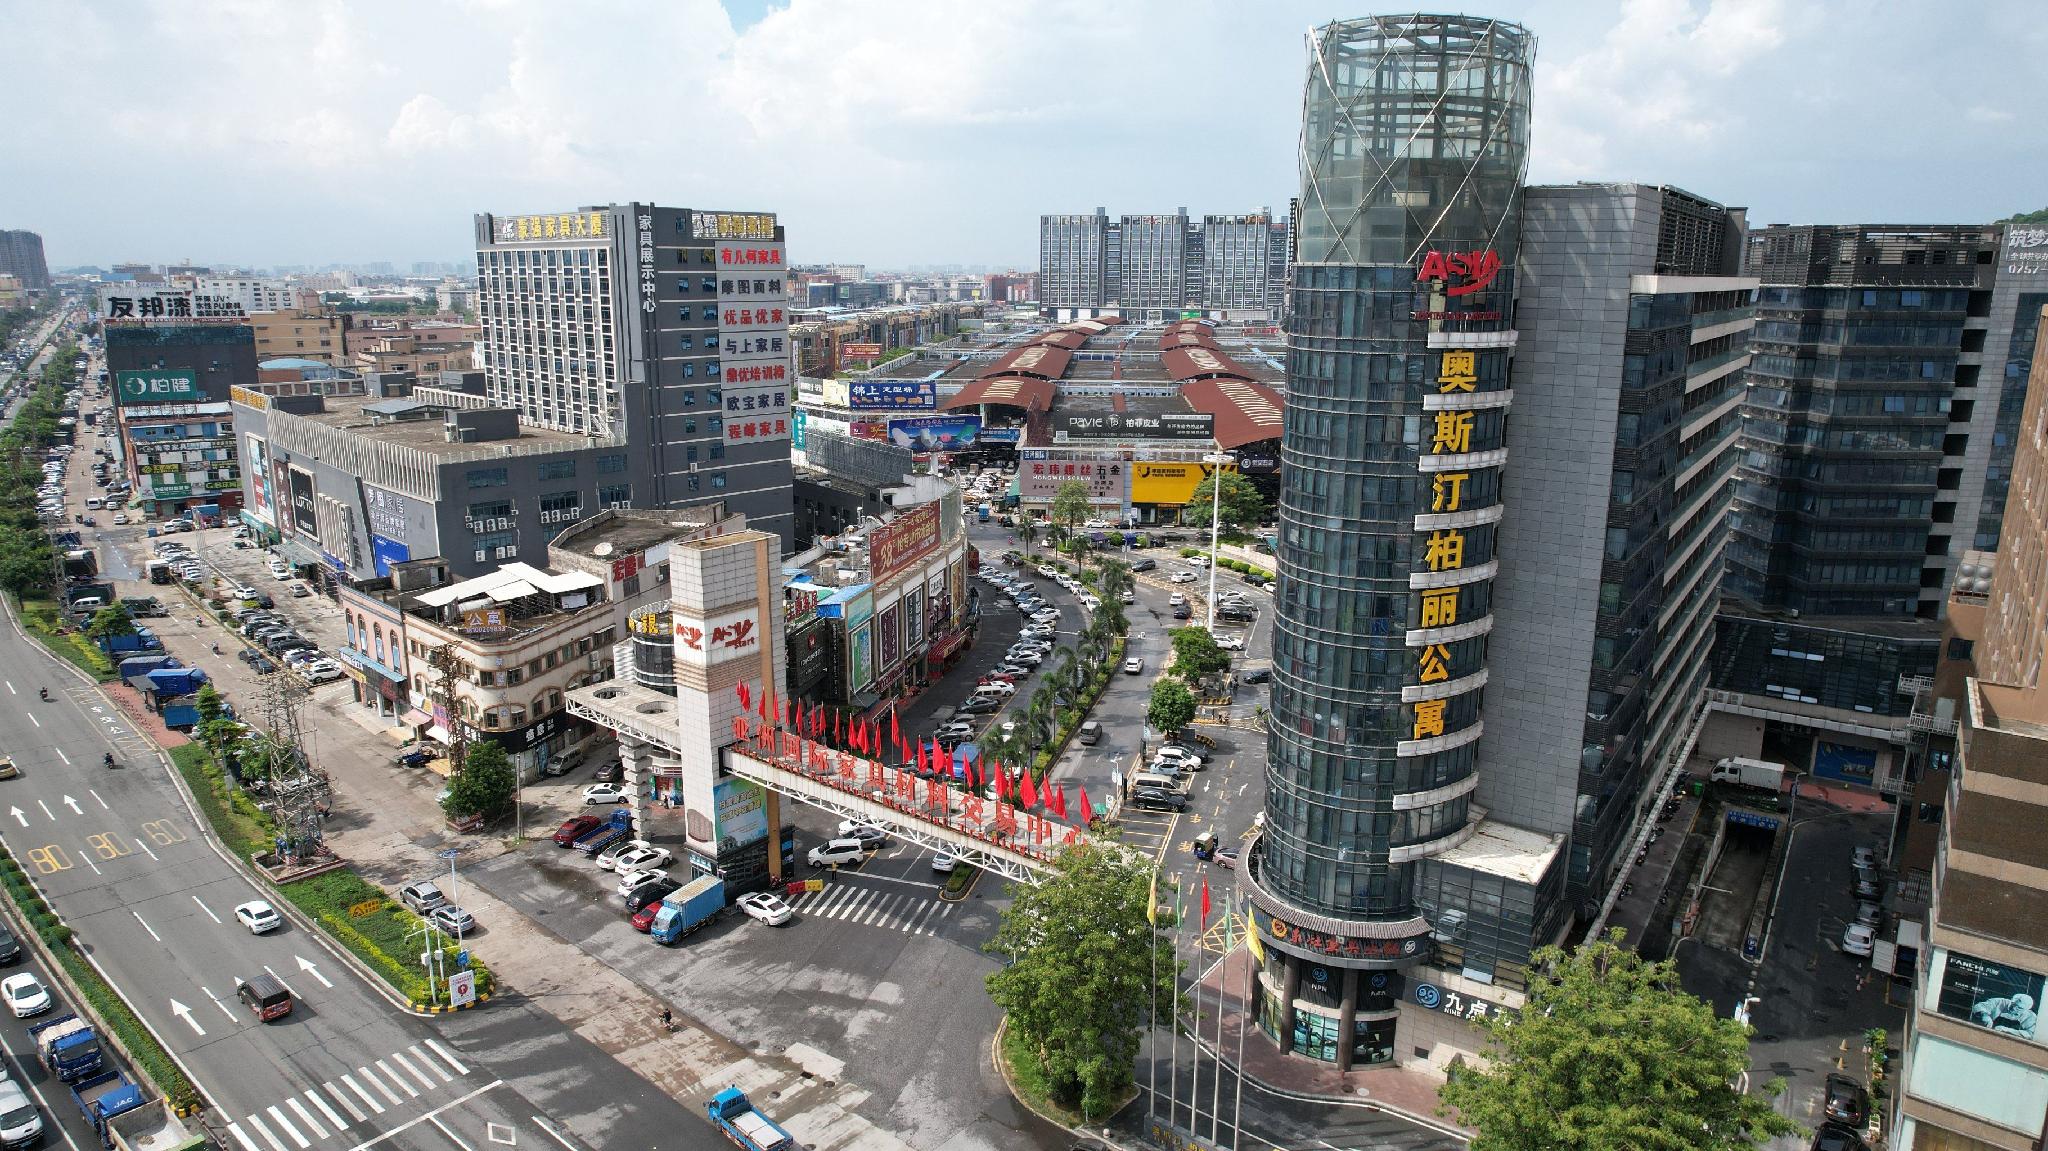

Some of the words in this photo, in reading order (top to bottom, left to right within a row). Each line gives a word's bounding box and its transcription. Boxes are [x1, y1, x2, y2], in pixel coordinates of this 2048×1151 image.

[639, 214, 656, 312] 家具展示中心
[721, 248, 782, 264] 有几何家具
[1418, 250, 1503, 297] ASIA
[722, 279, 781, 294] 摩图面料
[108, 296, 192, 317] 友邦漆
[724, 309, 783, 325] 优品优家
[725, 338, 783, 354] 与上家居
[727, 392, 786, 411] 欧宝家居
[1414, 350, 1478, 740] 奥斯汀柏丽公寓
[1444, 1007, 1461, 1017] NINE
